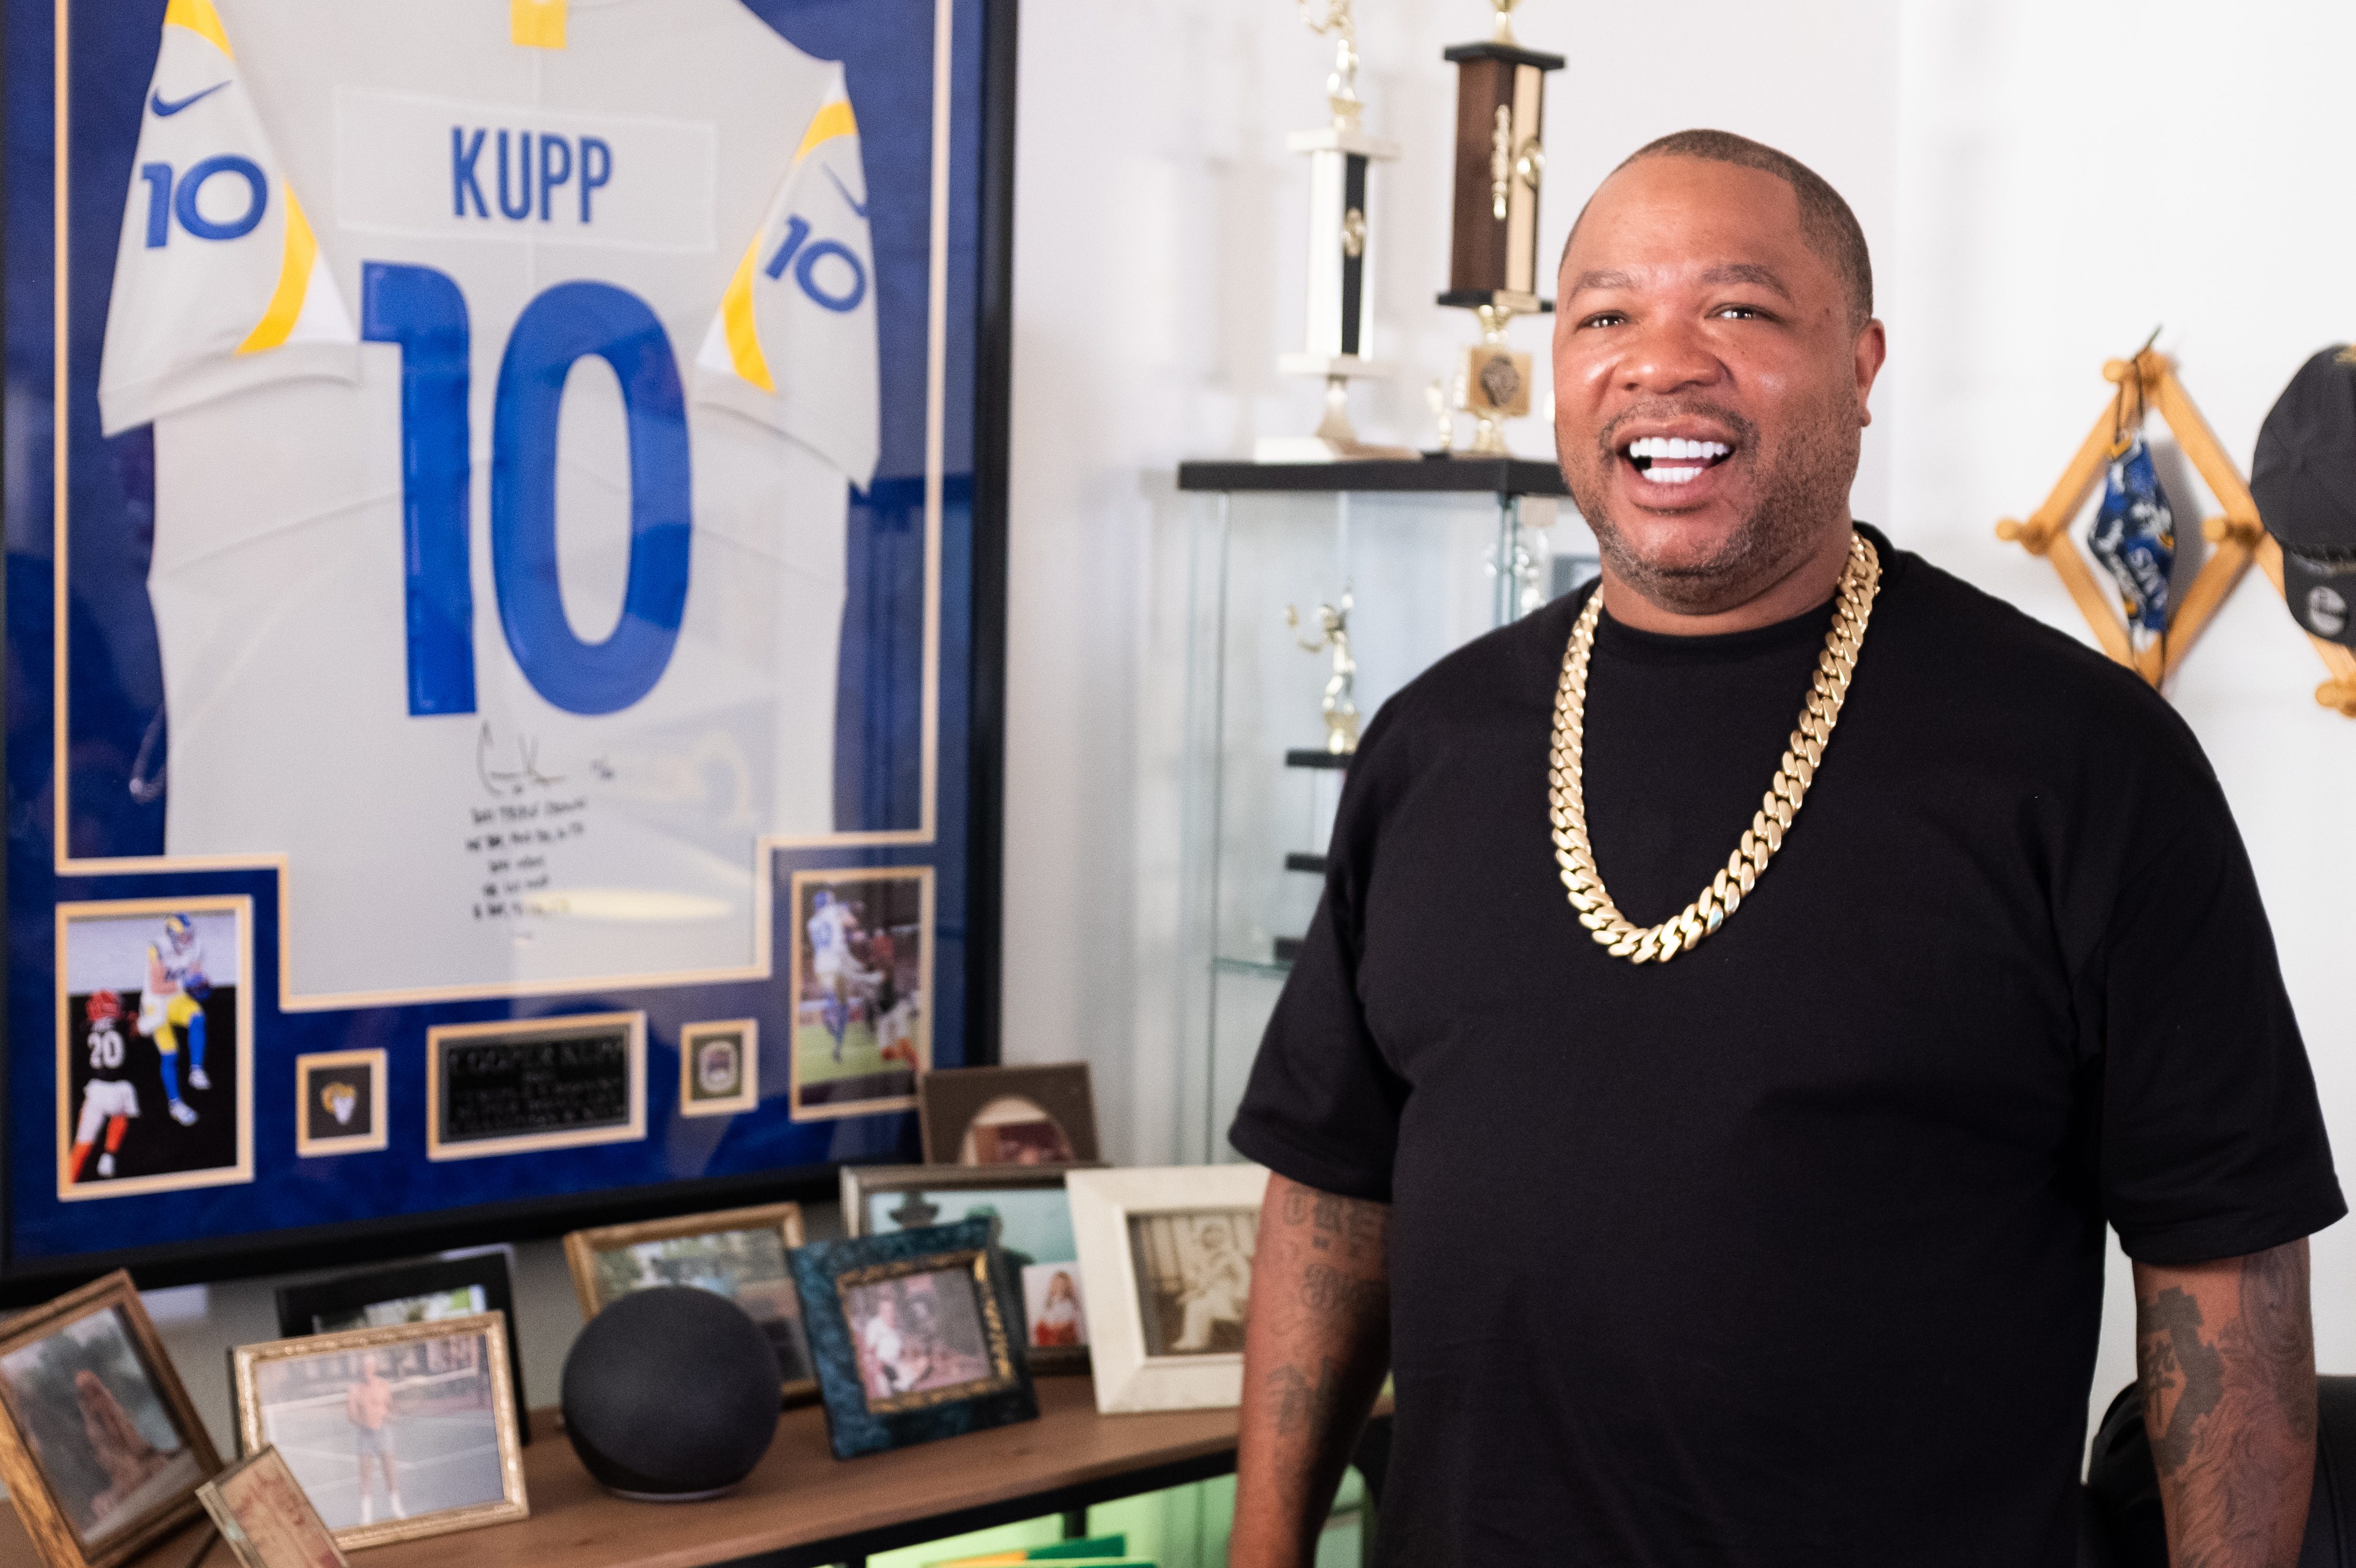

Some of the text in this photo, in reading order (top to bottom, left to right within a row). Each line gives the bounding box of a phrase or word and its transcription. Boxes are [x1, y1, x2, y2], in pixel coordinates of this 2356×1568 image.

[142, 154, 267, 249] 10
[452, 127, 612, 223] KUPP
[763, 214, 867, 313] 10
[361, 260, 692, 717] 10
[87, 1031, 125, 1069] 20
